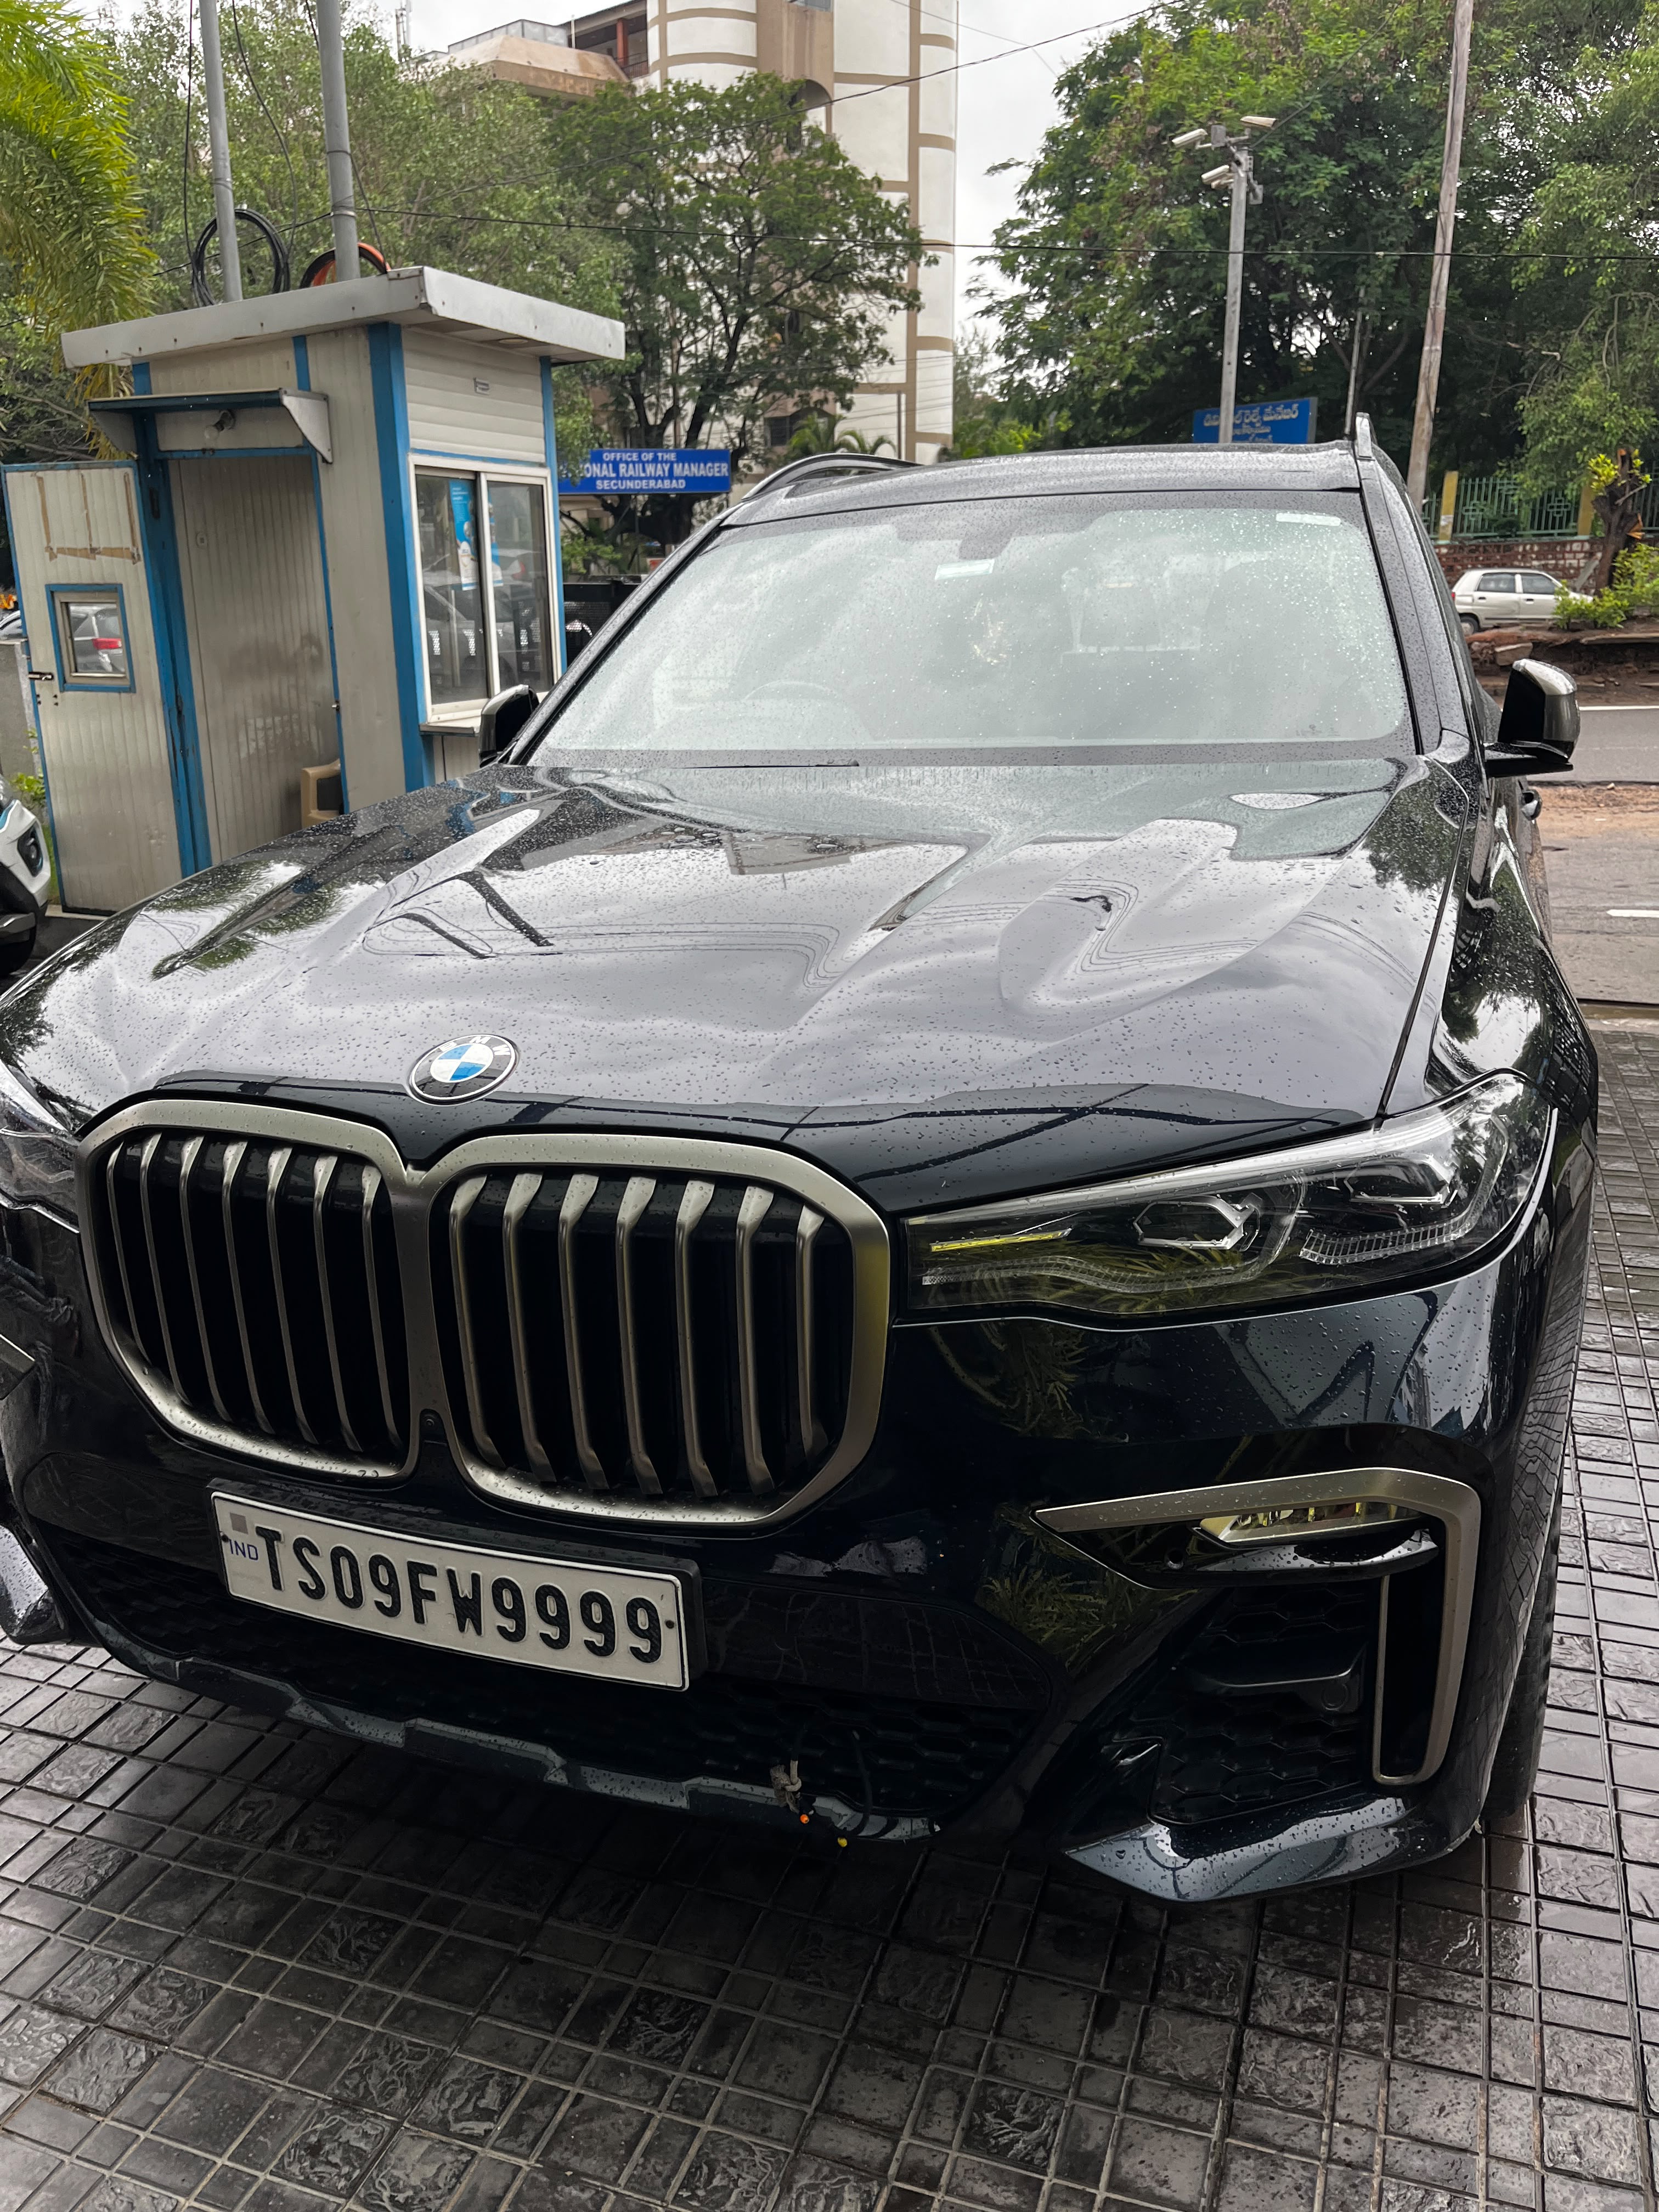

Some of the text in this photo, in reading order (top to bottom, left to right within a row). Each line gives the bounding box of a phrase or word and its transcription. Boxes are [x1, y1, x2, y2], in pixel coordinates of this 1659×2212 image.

[602, 452, 677, 461] OFFICE OF THE
[619, 462, 670, 477] RAILWAY
[674, 462, 729, 477] MANAGER
[596, 479, 686, 490] SECUNDERABAD
[438, 1036, 511, 1056] BMW
[229, 1539, 259, 1561] IND
[255, 1526, 662, 1664] TS09FW9999
